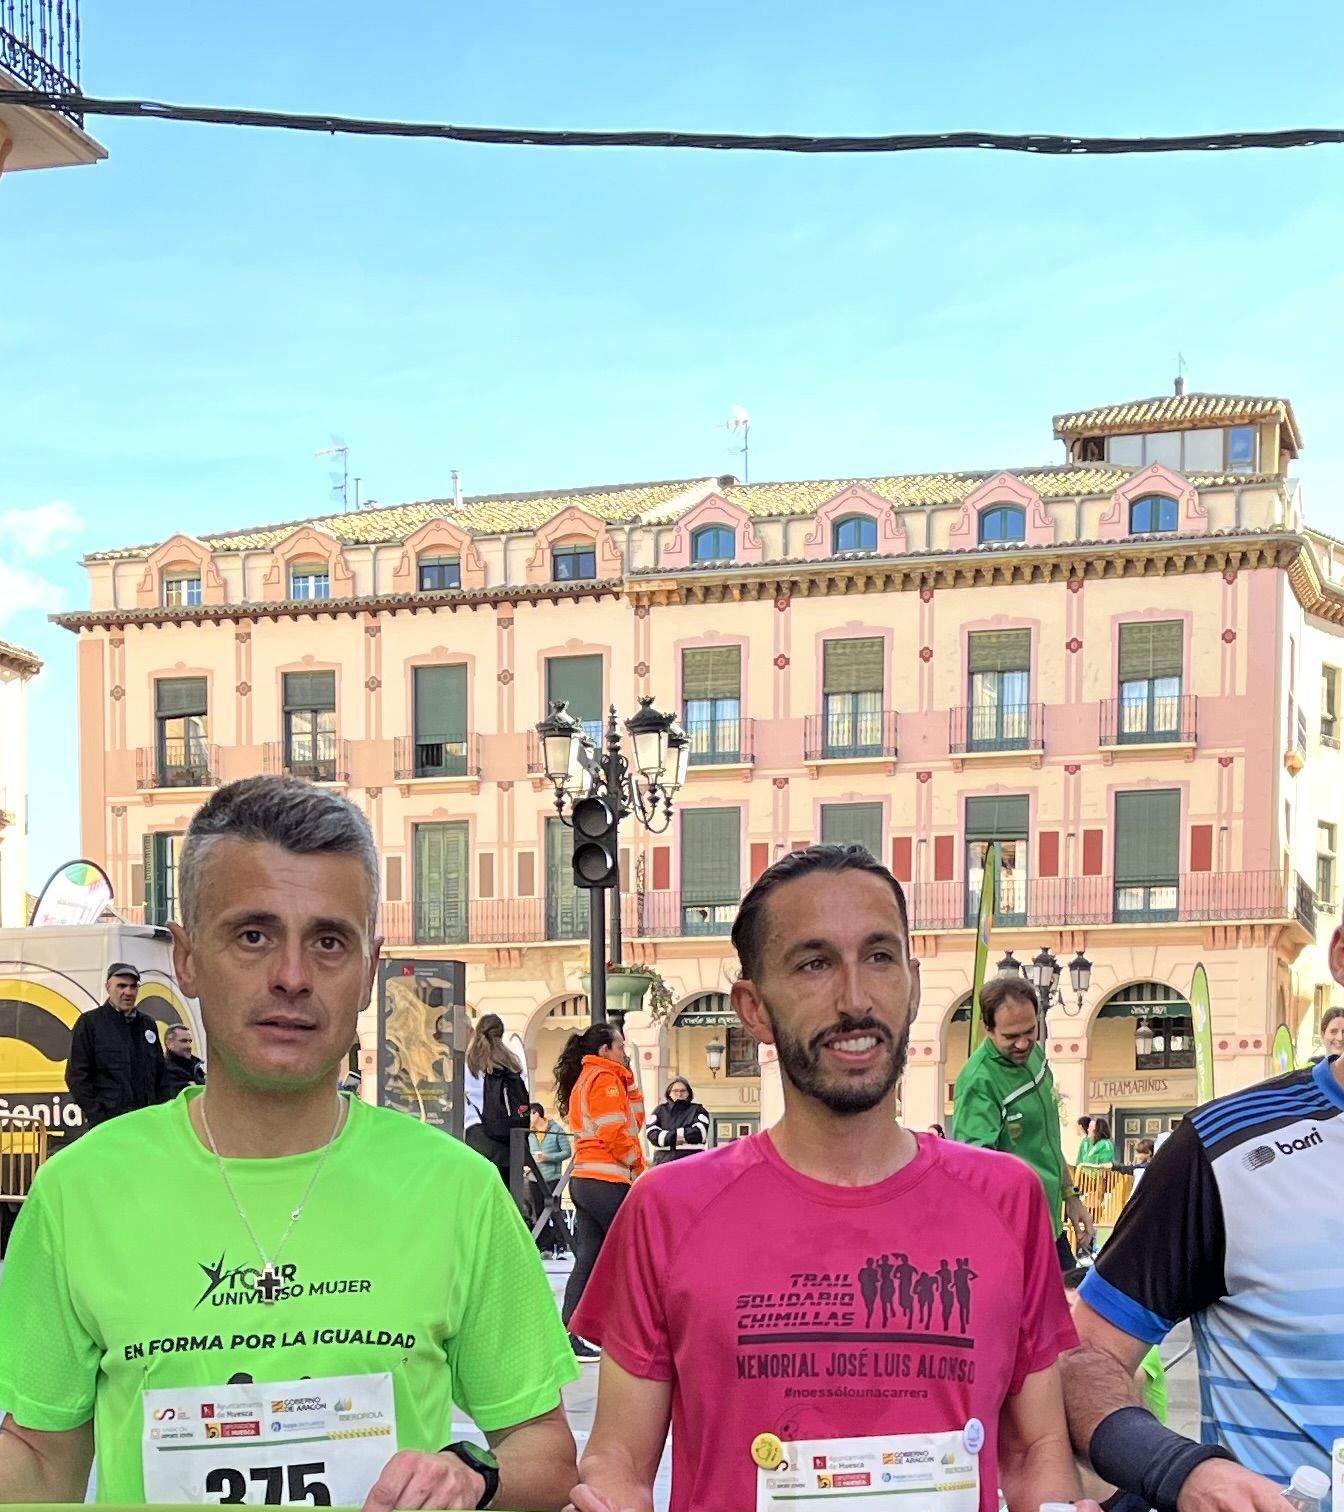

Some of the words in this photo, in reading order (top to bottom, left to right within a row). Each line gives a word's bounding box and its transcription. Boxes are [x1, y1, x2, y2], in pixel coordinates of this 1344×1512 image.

[1275, 1127, 1323, 1155] barri
[308, 1280, 371, 1296] MUJER
[789, 1273, 853, 1288] TRAIL
[736, 1292, 855, 1309] SOLIDARIO
[737, 1311, 855, 1329] CHIMILLAS
[125, 1342, 144, 1360] EN
[148, 1335, 224, 1356] FORMA
[230, 1334, 276, 1350] POR
[281, 1331, 306, 1348] LA
[312, 1329, 416, 1349] IGUALDAD
[736, 1353, 820, 1379] MEMORIAL
[825, 1349, 868, 1378] JOSÉ
[873, 1354, 912, 1378] LUIS
[916, 1354, 976, 1384] ALONSO
